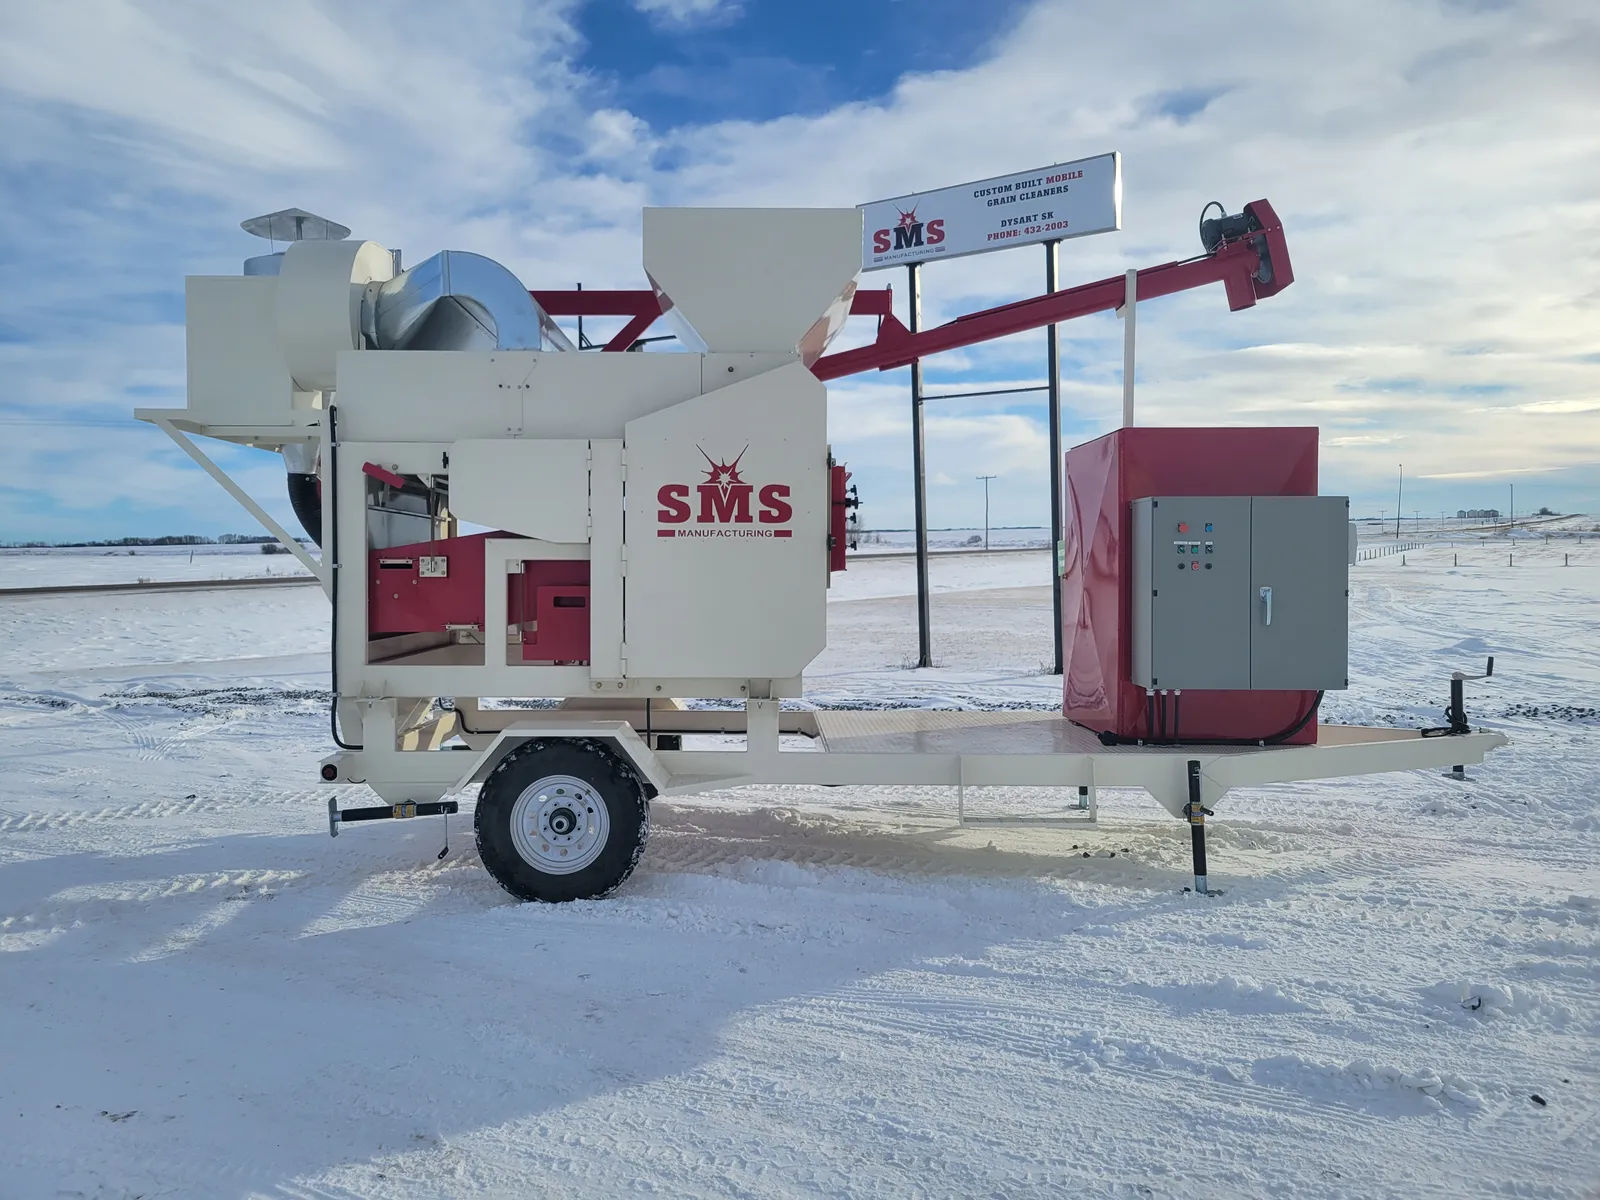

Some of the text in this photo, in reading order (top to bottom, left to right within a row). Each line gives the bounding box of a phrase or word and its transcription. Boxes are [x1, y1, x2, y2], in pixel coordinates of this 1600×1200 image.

[974, 170, 1083, 198] CUSTOM BUILT MOBILE
[987, 185, 1069, 207] GRAIN CLEANERS
[1001, 211, 1054, 228] DYSART SK
[873, 219, 945, 254] SMS
[987, 220, 1069, 241] PHONE: 432-2003
[884, 248, 934, 261] MANUFACTURING
[657, 484, 793, 524] SMS
[677, 529, 773, 538] MANUFACTURING
